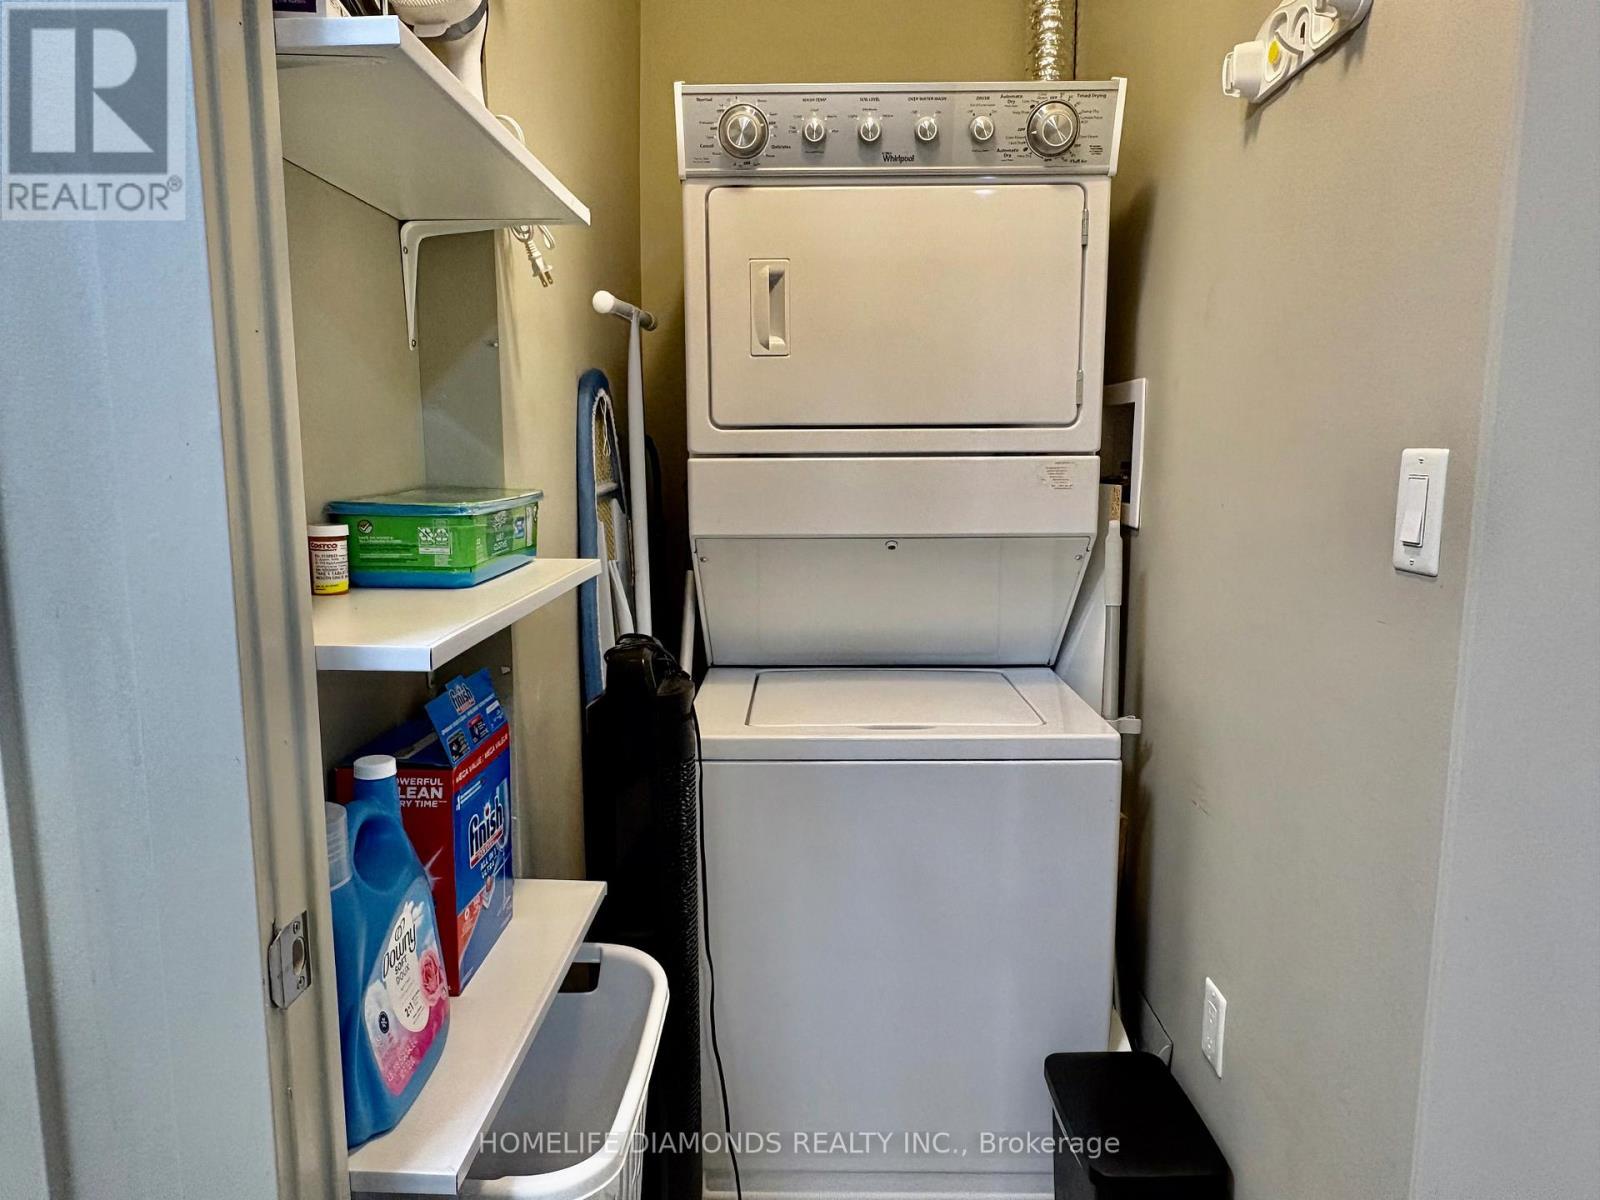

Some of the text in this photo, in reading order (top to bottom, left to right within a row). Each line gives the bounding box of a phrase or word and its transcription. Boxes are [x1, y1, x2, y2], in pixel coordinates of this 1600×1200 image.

[882, 153, 915, 164] Whirlpool
[397, 777, 443, 786] WERFUL
[398, 786, 443, 799] LEAN
[469, 796, 504, 858] finish
[383, 923, 417, 979] Downy
